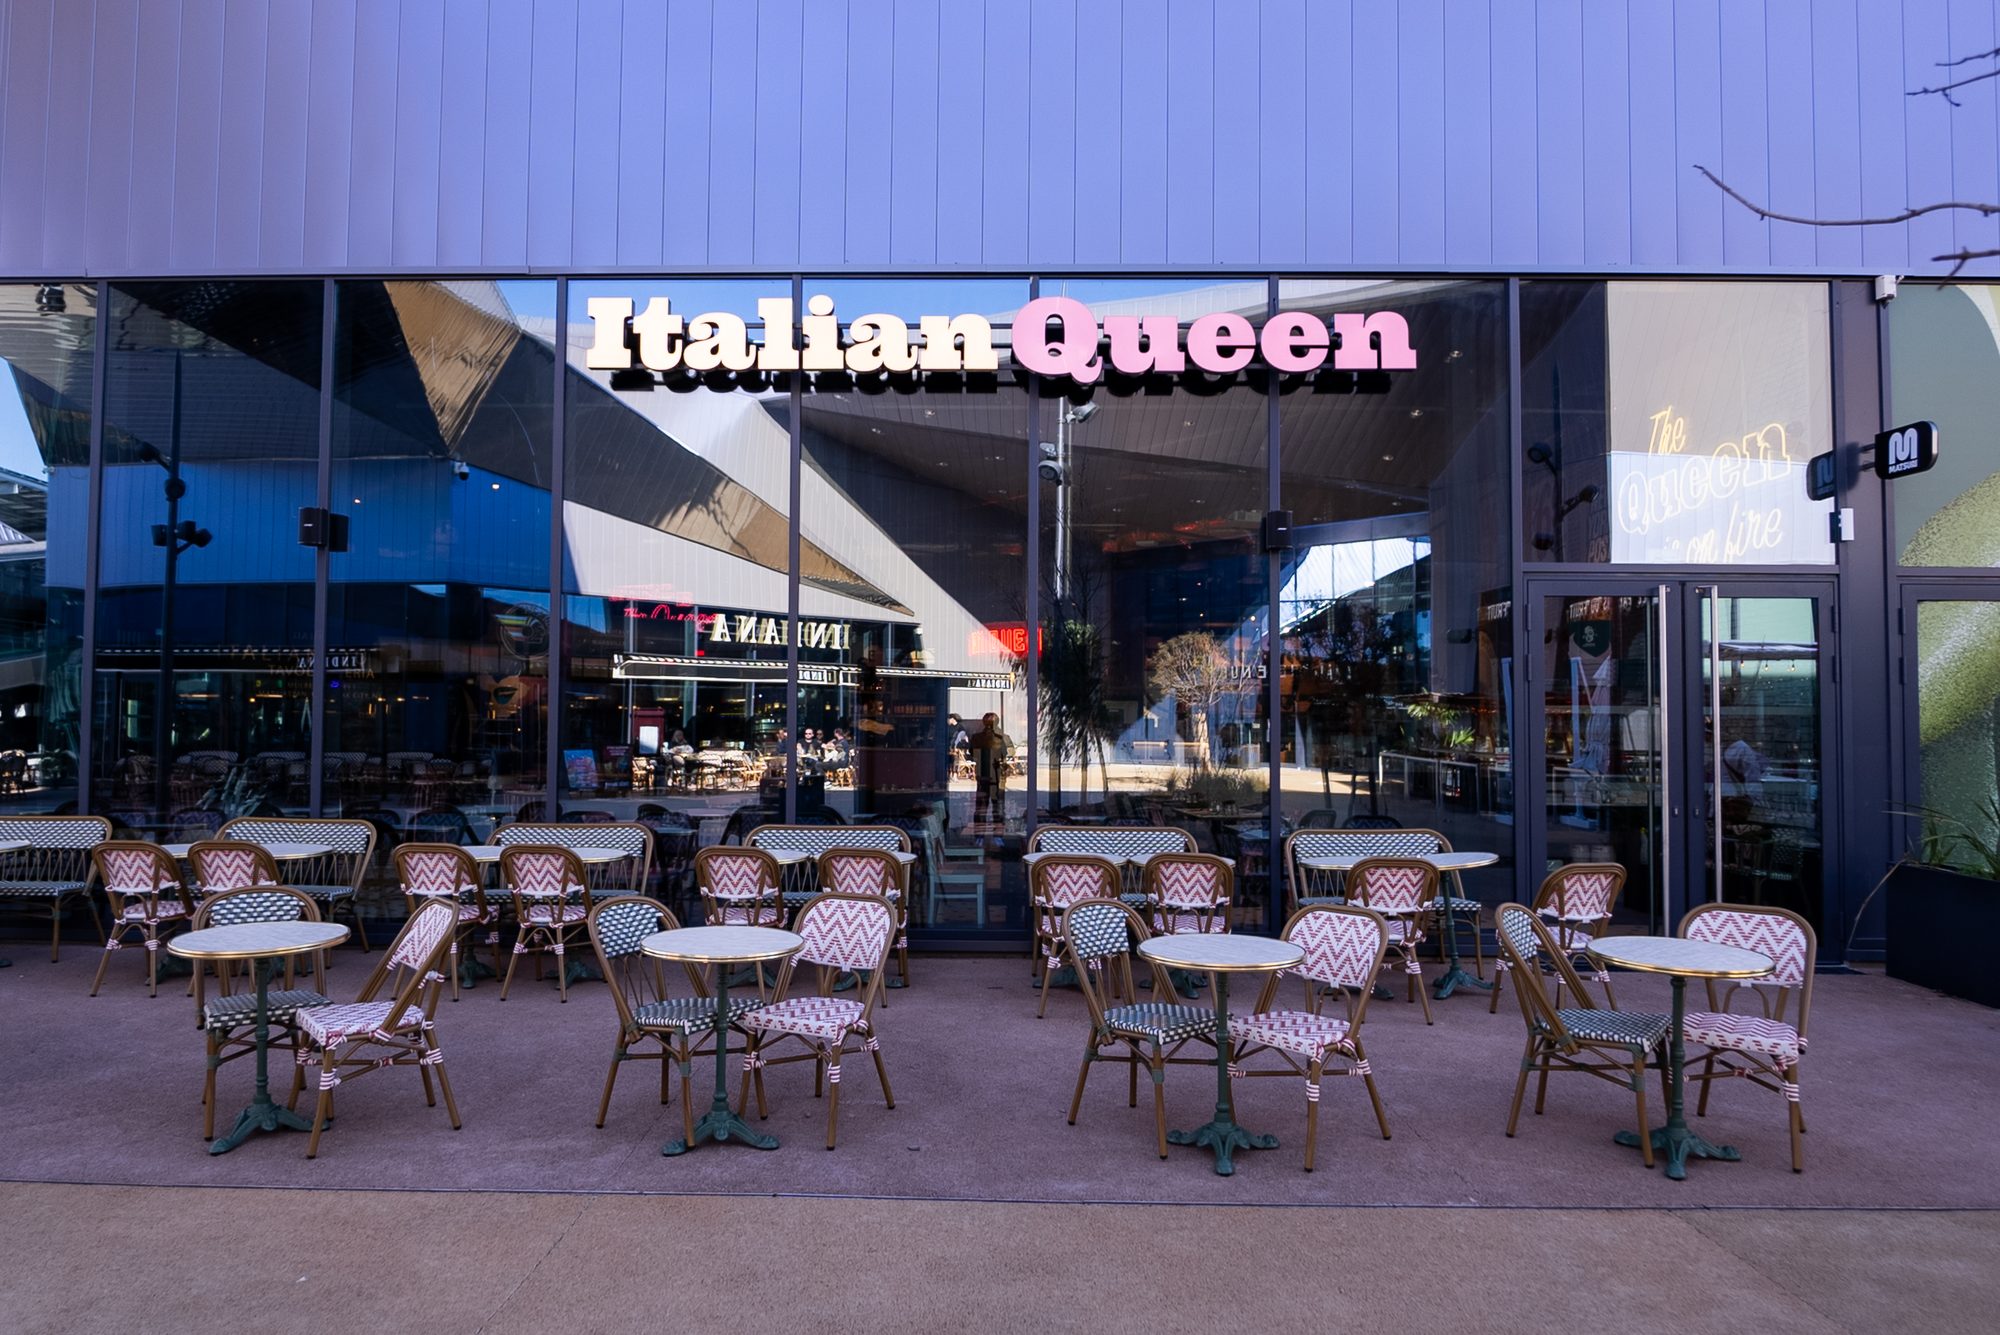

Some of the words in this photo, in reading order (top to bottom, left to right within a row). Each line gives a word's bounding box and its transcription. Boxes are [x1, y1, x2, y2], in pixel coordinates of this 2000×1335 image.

[586, 294, 998, 372] Italian
[1011, 296, 1417, 386] Queen
[1649, 405, 1686, 458] The
[1618, 423, 1791, 535] Queen
